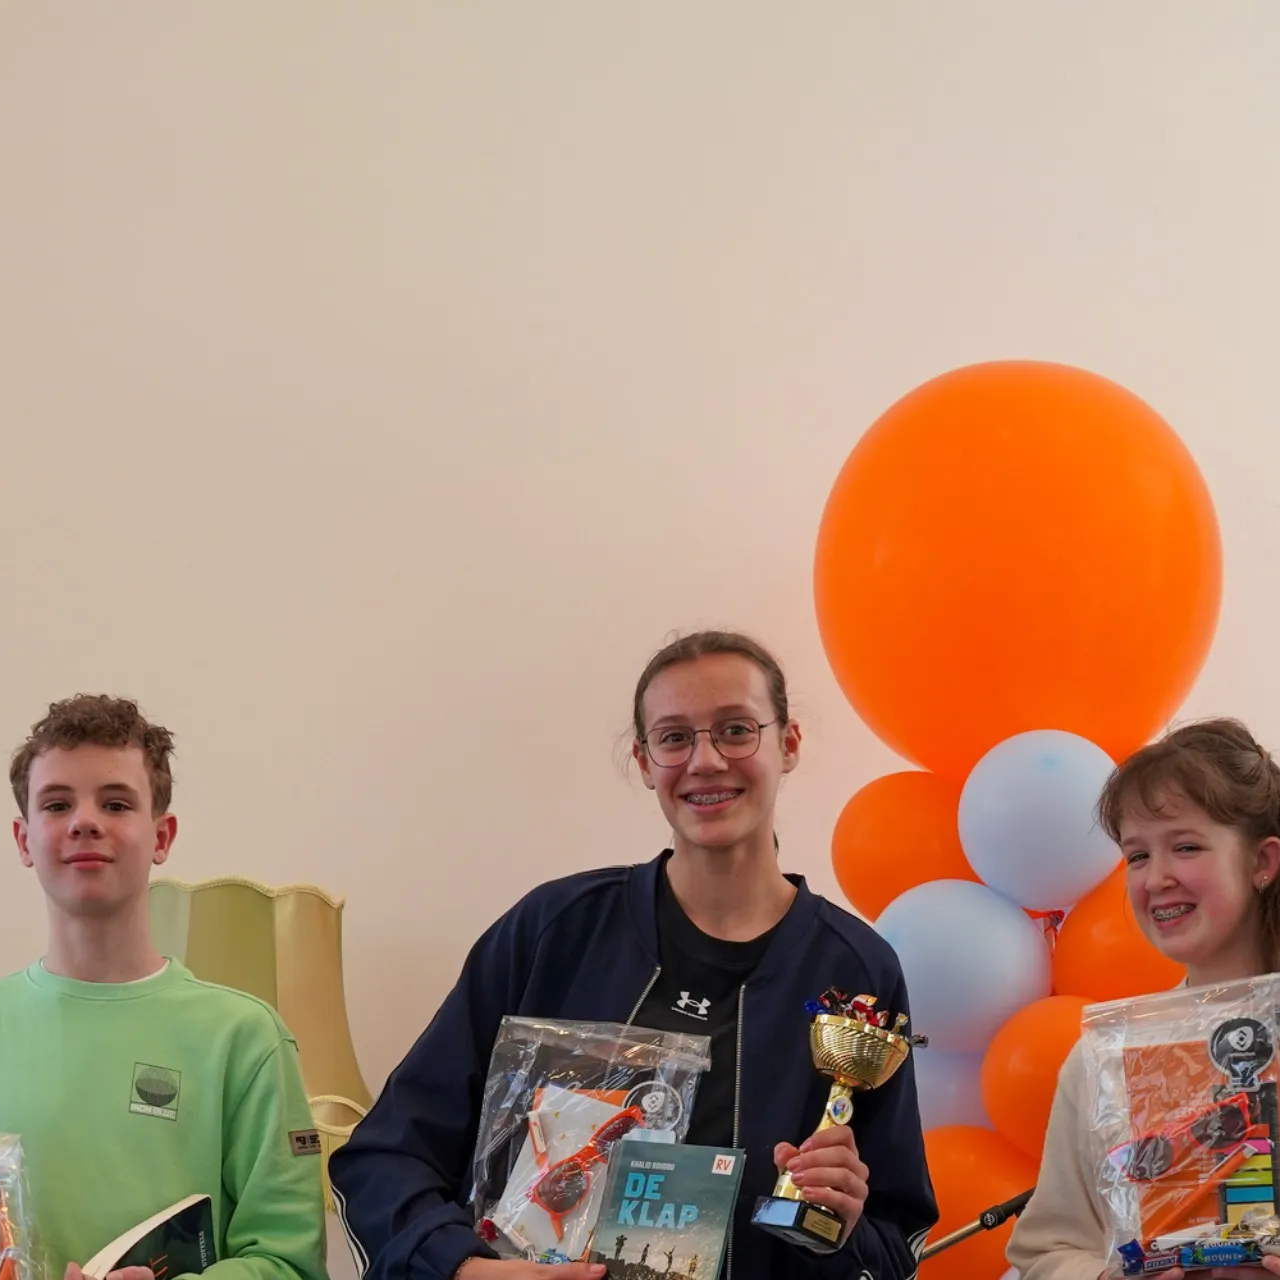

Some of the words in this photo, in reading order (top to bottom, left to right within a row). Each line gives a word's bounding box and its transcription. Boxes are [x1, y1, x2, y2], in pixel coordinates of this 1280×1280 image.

[715, 1158, 732, 1171] RV
[624, 1172, 665, 1200] DE
[617, 1199, 699, 1230] KLAP
